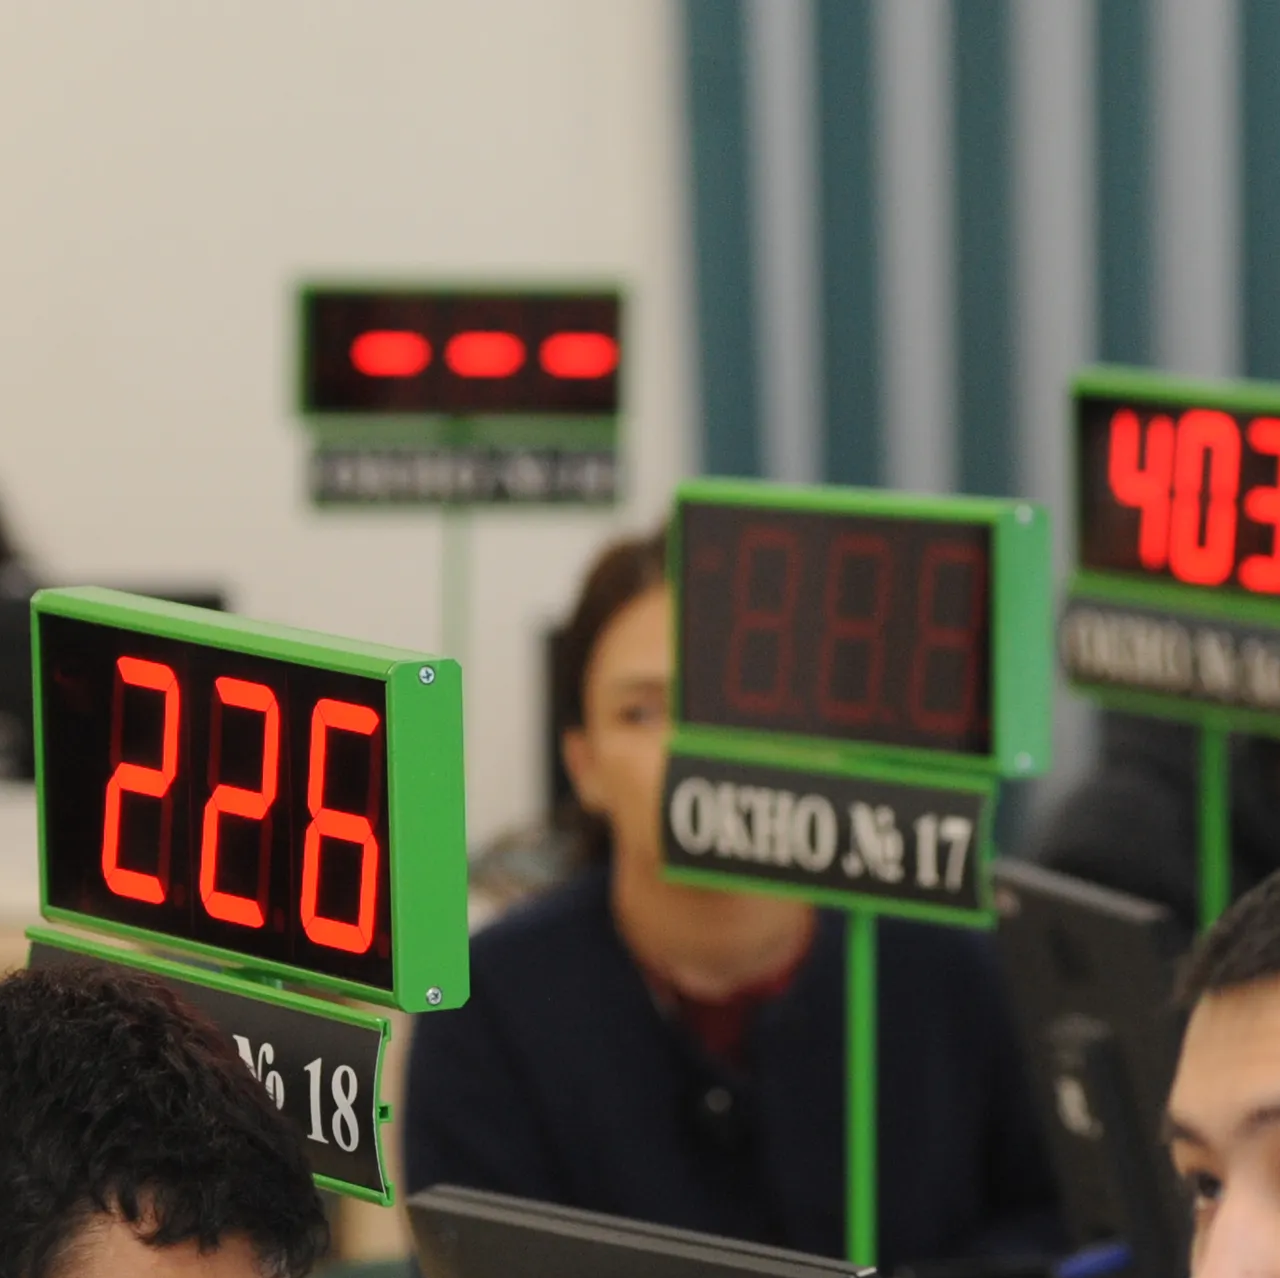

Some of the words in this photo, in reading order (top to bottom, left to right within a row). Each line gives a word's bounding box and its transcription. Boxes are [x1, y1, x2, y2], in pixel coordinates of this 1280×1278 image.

[101, 655, 380, 955] 226
[670, 776, 837, 872] ОКНО
[914, 811, 973, 891] 17
[303, 1057, 360, 1153] 18
